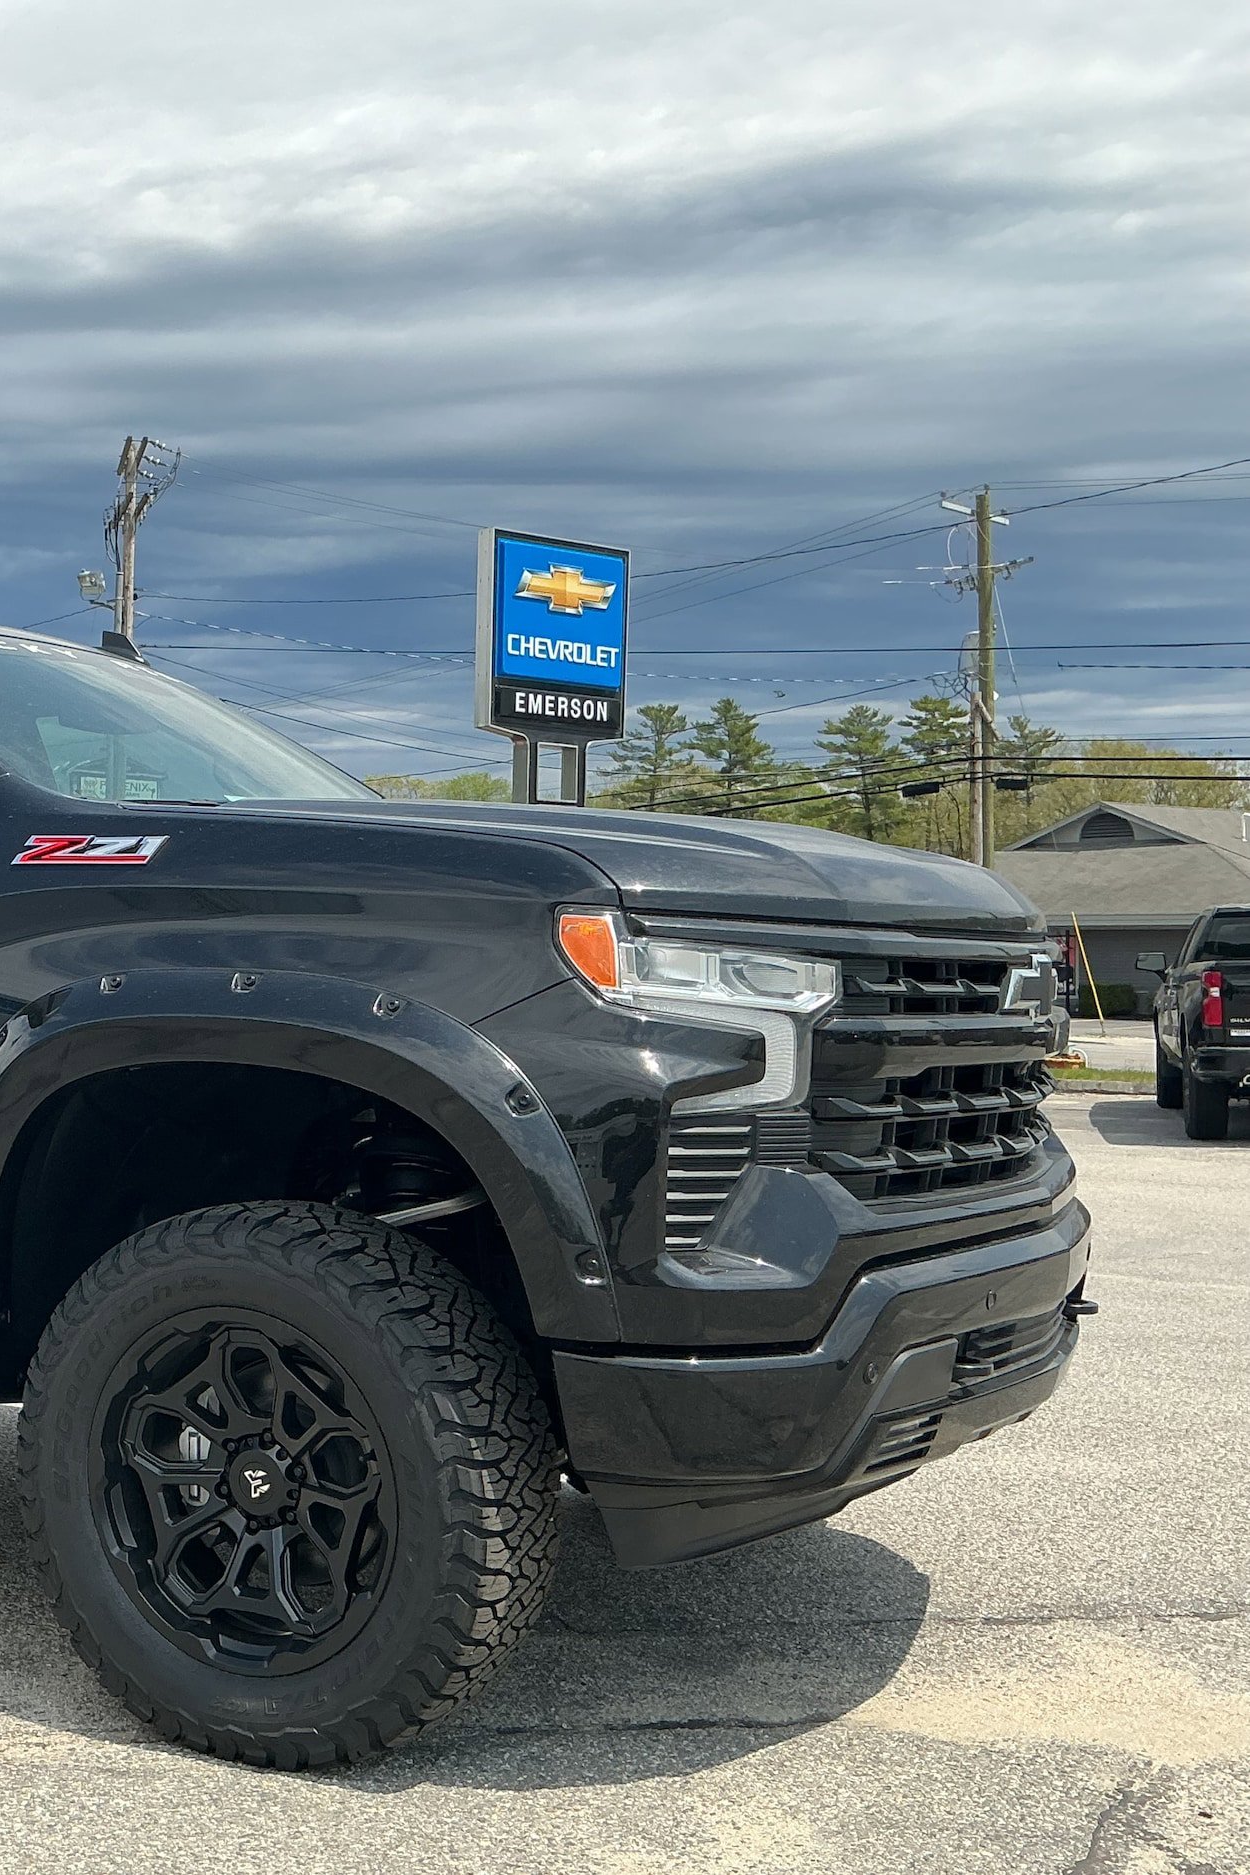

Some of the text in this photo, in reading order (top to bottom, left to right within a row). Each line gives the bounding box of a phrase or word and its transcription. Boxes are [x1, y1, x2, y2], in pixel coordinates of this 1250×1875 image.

[507, 633, 619, 668] CHEVROLET
[514, 691, 608, 722] EMERSON
[10, 834, 171, 866] Z71
